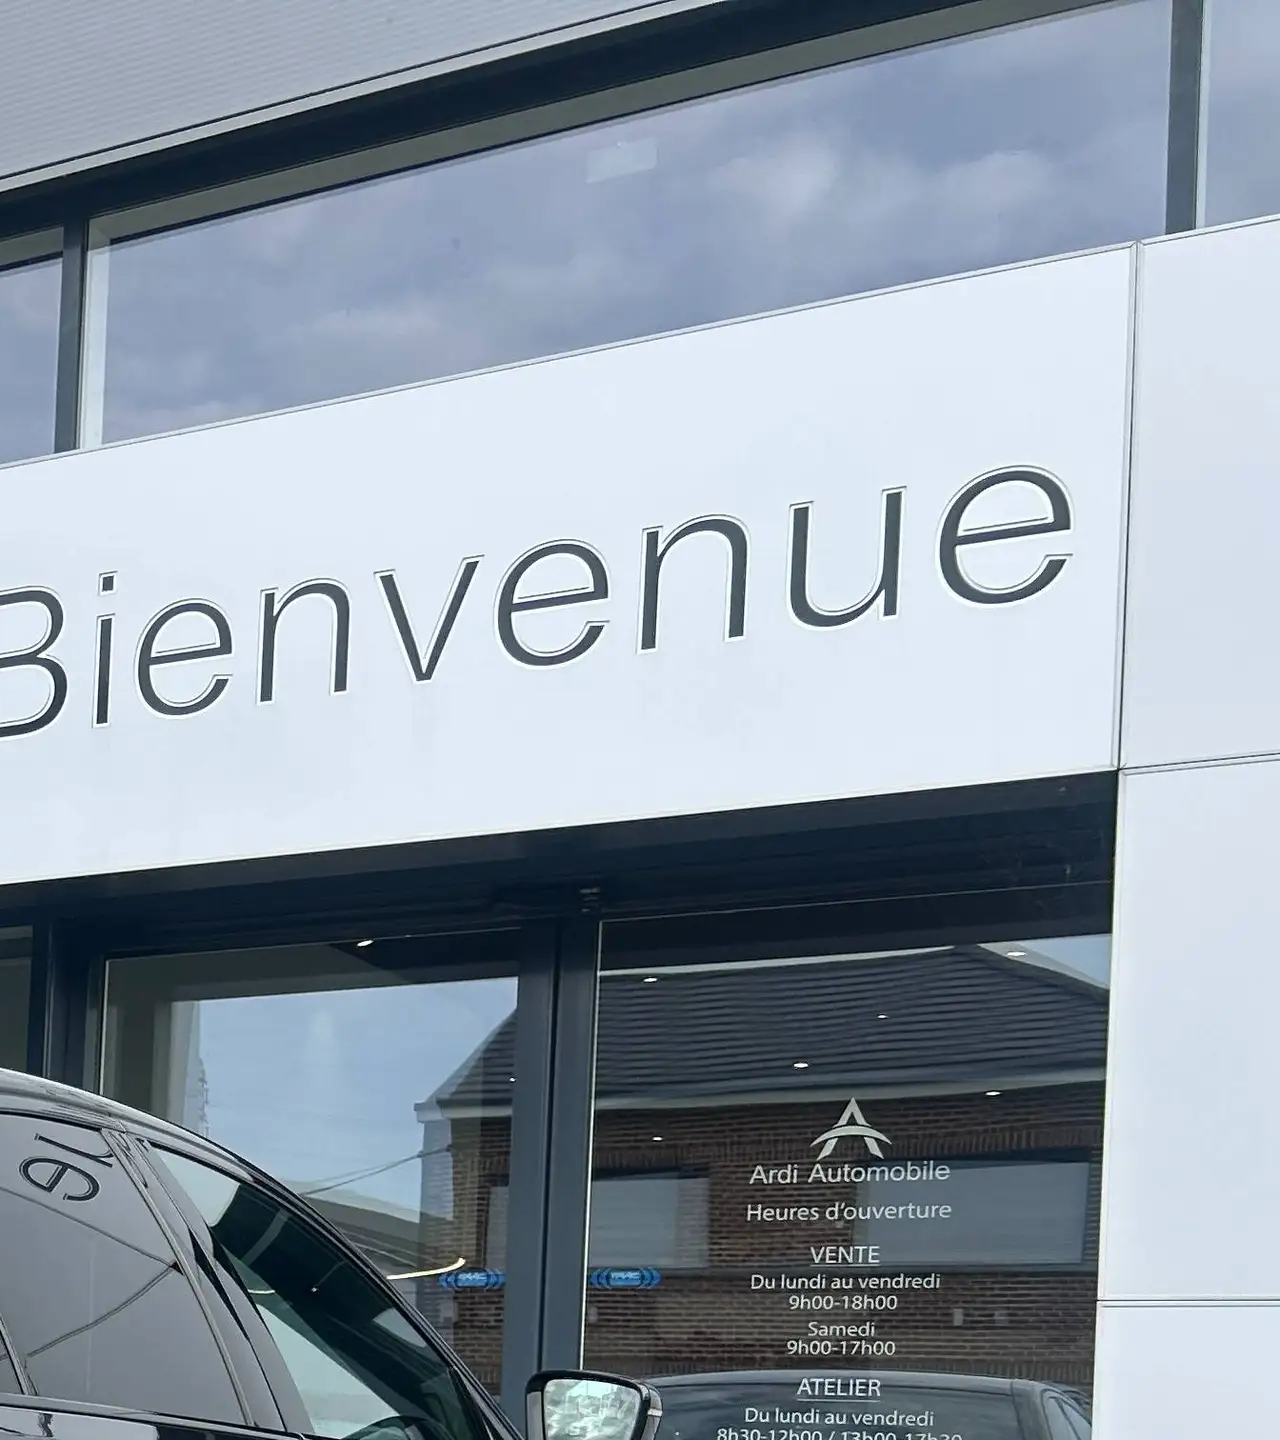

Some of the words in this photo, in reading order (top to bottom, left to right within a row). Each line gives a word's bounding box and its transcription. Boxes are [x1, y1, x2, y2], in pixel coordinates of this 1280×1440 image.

[749, 1163, 799, 1185] Ardi
[807, 1160, 951, 1184] Automobile
[746, 1203, 820, 1222] Heures
[825, 1202, 952, 1222] d'ouverture
[810, 1245, 881, 1264] VENTE
[750, 1274, 775, 1290] Du
[780, 1273, 826, 1291] lundi
[831, 1277, 854, 1290] au
[858, 1273, 941, 1290] vendredi
[788, 1294, 898, 1311] 9h00-18h00
[807, 1321, 876, 1337] Samedi
[786, 1339, 896, 1357] 9h00-17h00
[797, 1378, 881, 1398] ATELIER
[744, 1407, 770, 1423] Du
[775, 1407, 820, 1425] lundi
[825, 1412, 847, 1425] au
[851, 1410, 934, 1427] vendredi
